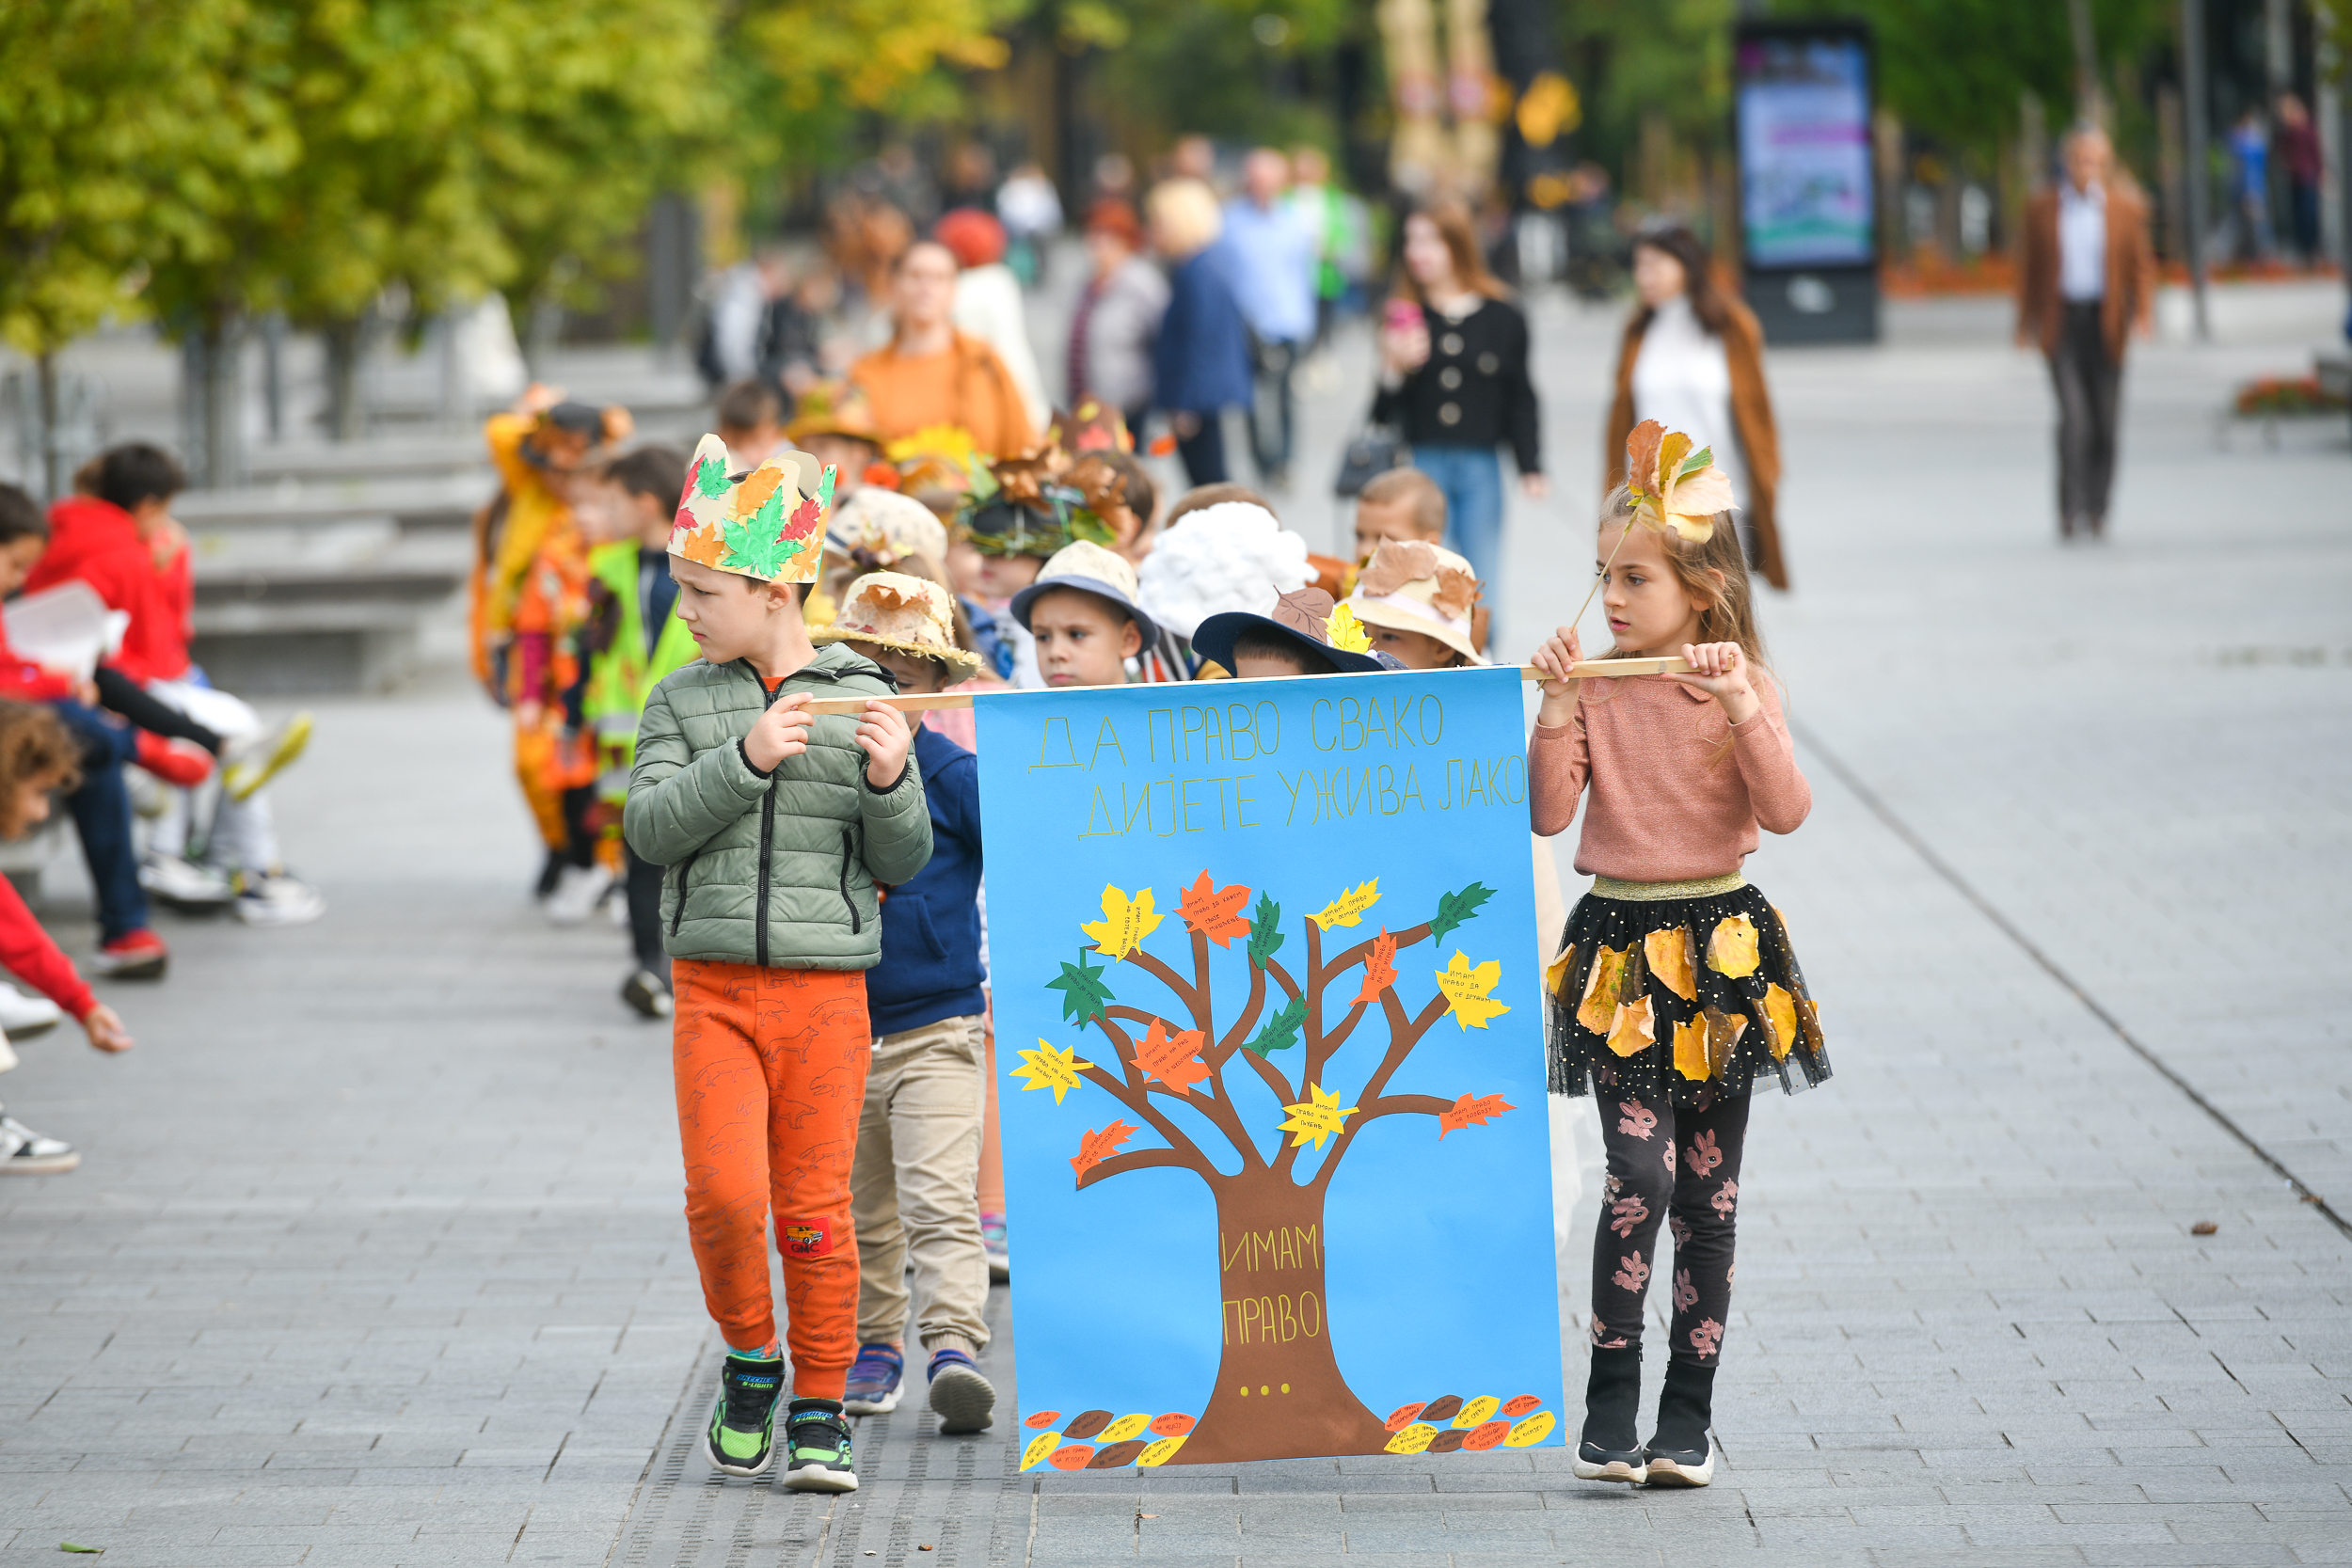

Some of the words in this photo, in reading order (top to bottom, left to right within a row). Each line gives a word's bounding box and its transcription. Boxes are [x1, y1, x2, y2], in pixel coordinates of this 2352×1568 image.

[1028, 716, 1127, 774] ДА
[1149, 701, 1280, 764] ПРАВО
[1311, 693, 1443, 752] СВАКО
[1077, 774, 1260, 840] ДИЈЕТЕ
[1278, 762, 1425, 827] УЖИВА
[1438, 755, 1525, 811] ЛАКО
[1193, 906, 1210, 917] ПРАВО
[1222, 891, 1242, 903] КАЖЕМ
[1324, 905, 1345, 918] ИМАМ
[1348, 895, 1367, 907] ПРАВО
[1077, 970, 1093, 987] ИМАМ
[1450, 970, 1475, 980] ИМАМ
[1466, 993, 1491, 1003] ДРУЖИМ
[1261, 1027, 1278, 1042] ИМАМ
[1280, 1013, 1296, 1028] ПРАВО
[1047, 1052, 1064, 1067] ИМАМ
[1145, 1044, 1160, 1058] ИМАМ
[1152, 1054, 1168, 1067] ПРАВО
[1178, 1038, 1189, 1047] РАД
[1296, 1108, 1314, 1117] ПРАВО
[1316, 1103, 1333, 1112] ИМАМ
[1449, 1108, 1467, 1118] ИМАМ
[1472, 1100, 1491, 1110] ПРАВО
[791, 1243, 820, 1253] GMC
[1222, 1224, 1319, 1272] ИМАМ
[1222, 1291, 1321, 1345] ПРАВО
